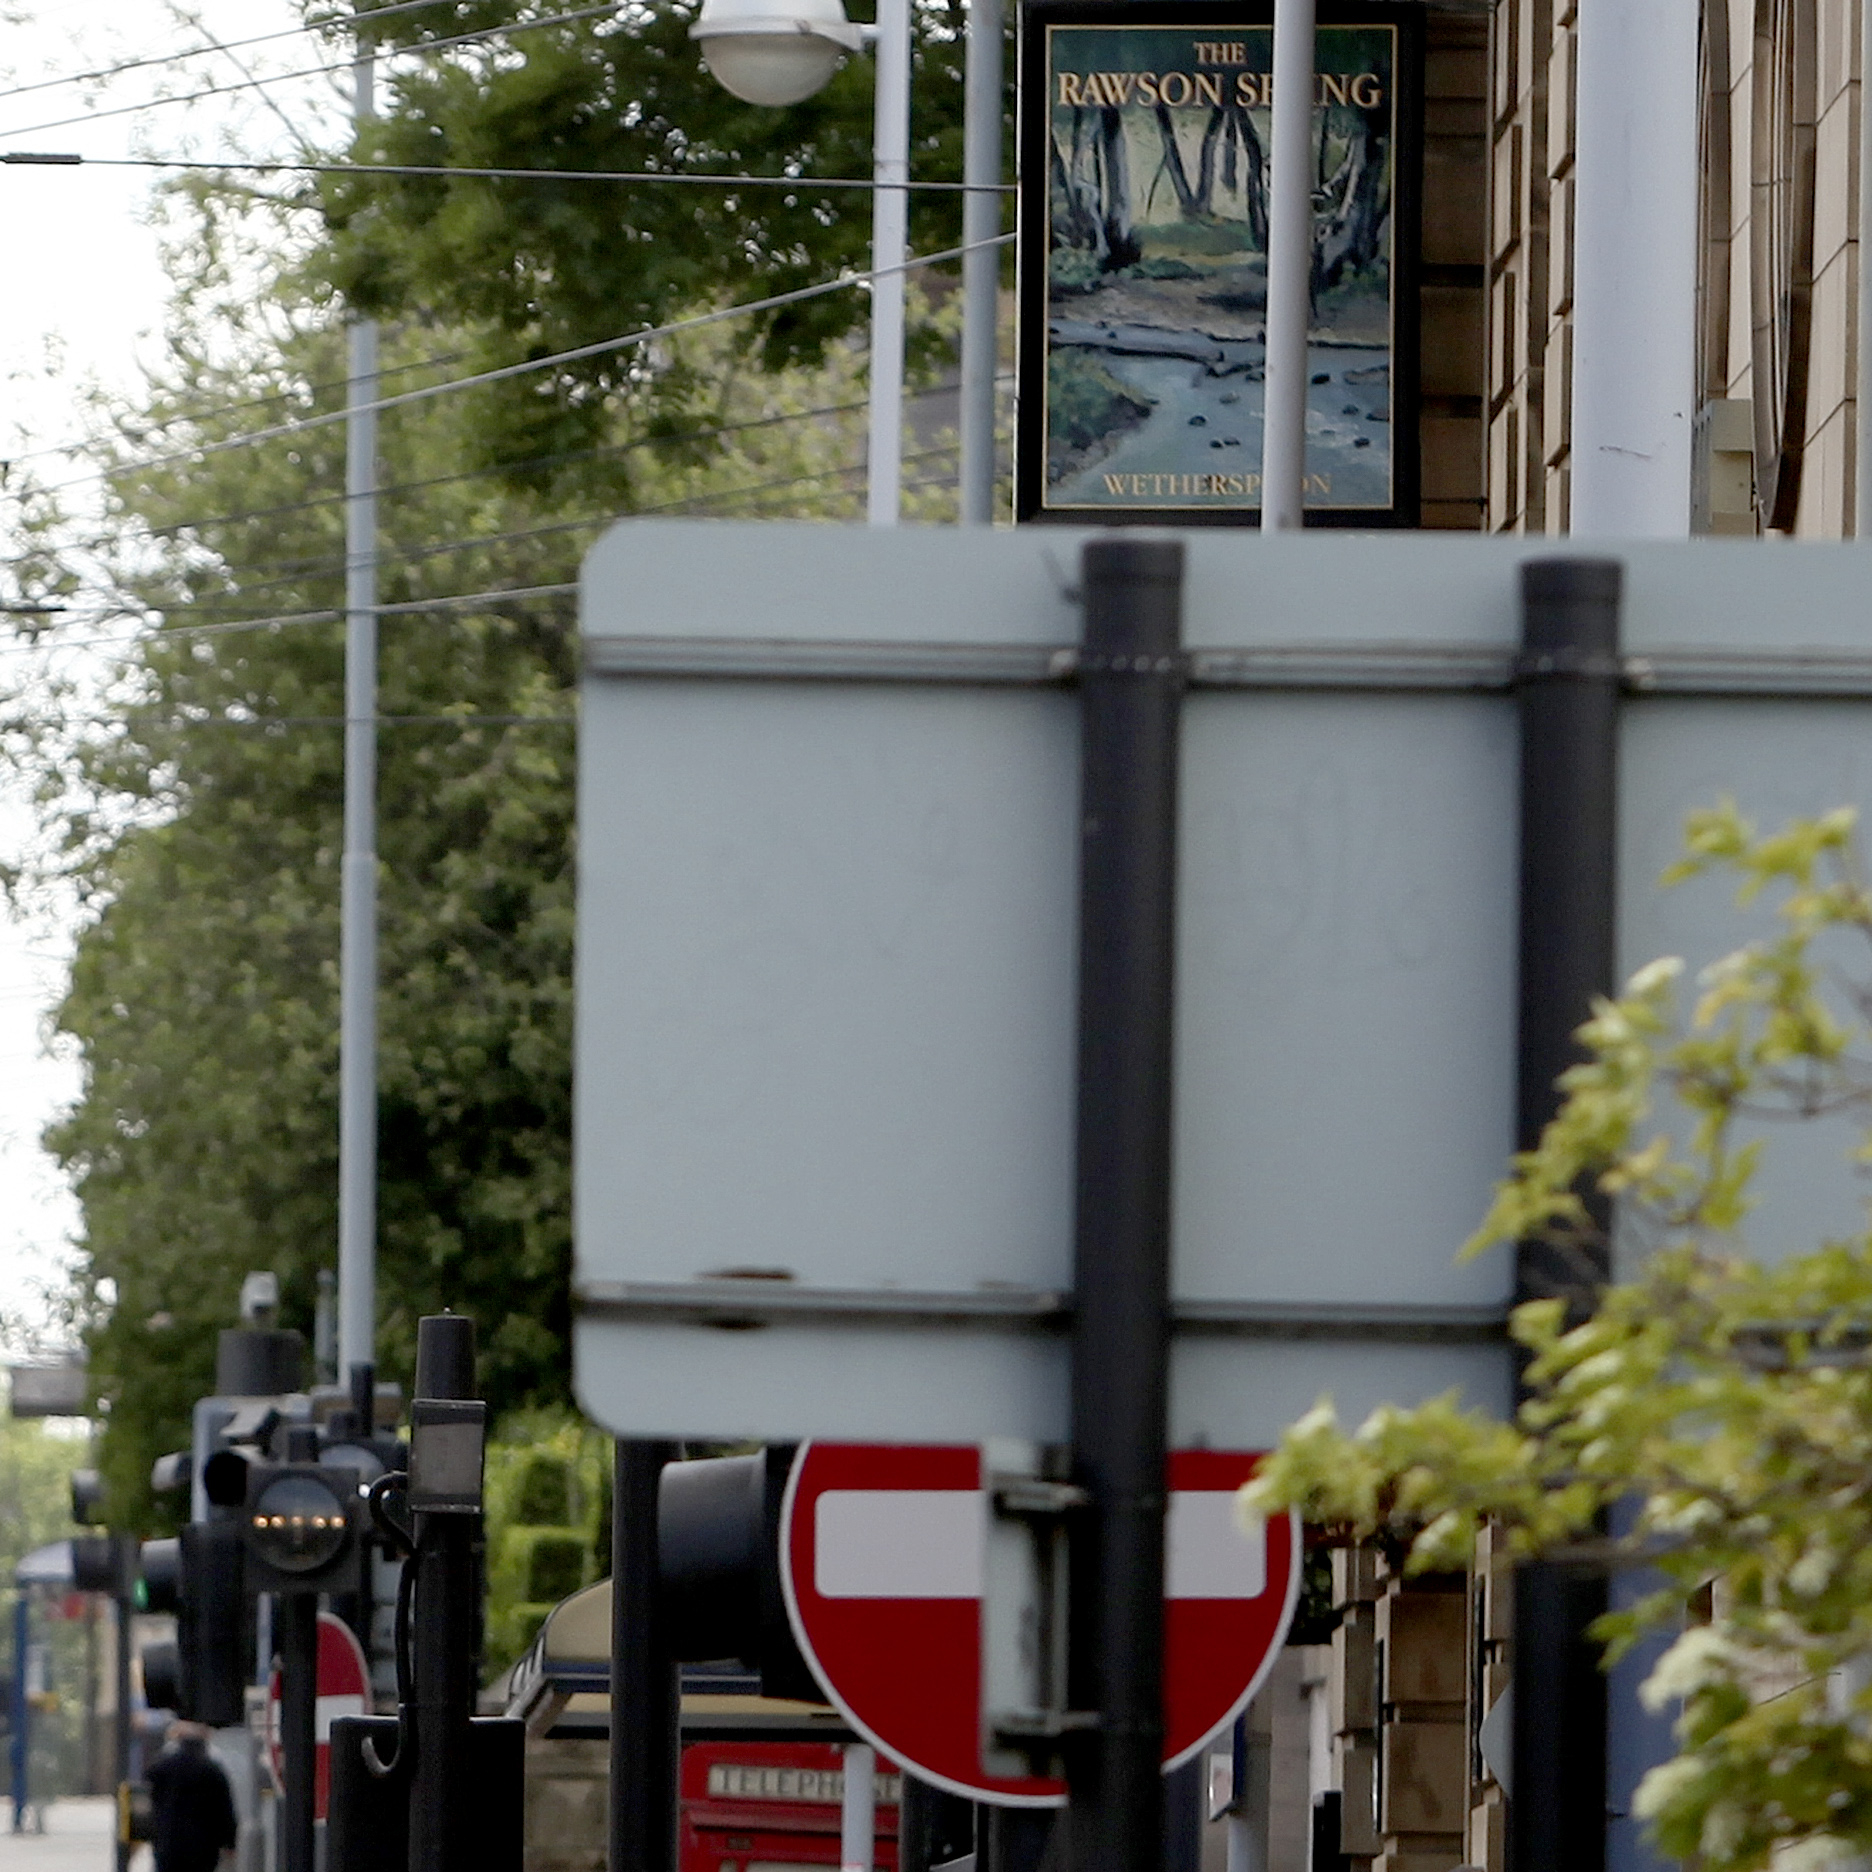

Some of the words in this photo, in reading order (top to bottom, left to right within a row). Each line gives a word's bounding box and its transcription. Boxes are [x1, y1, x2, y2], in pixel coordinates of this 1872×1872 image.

[1193, 41, 1247, 66] THE
[1057, 71, 1221, 108] RAWSON
[1102, 472, 1333, 496] WETHERSPN
